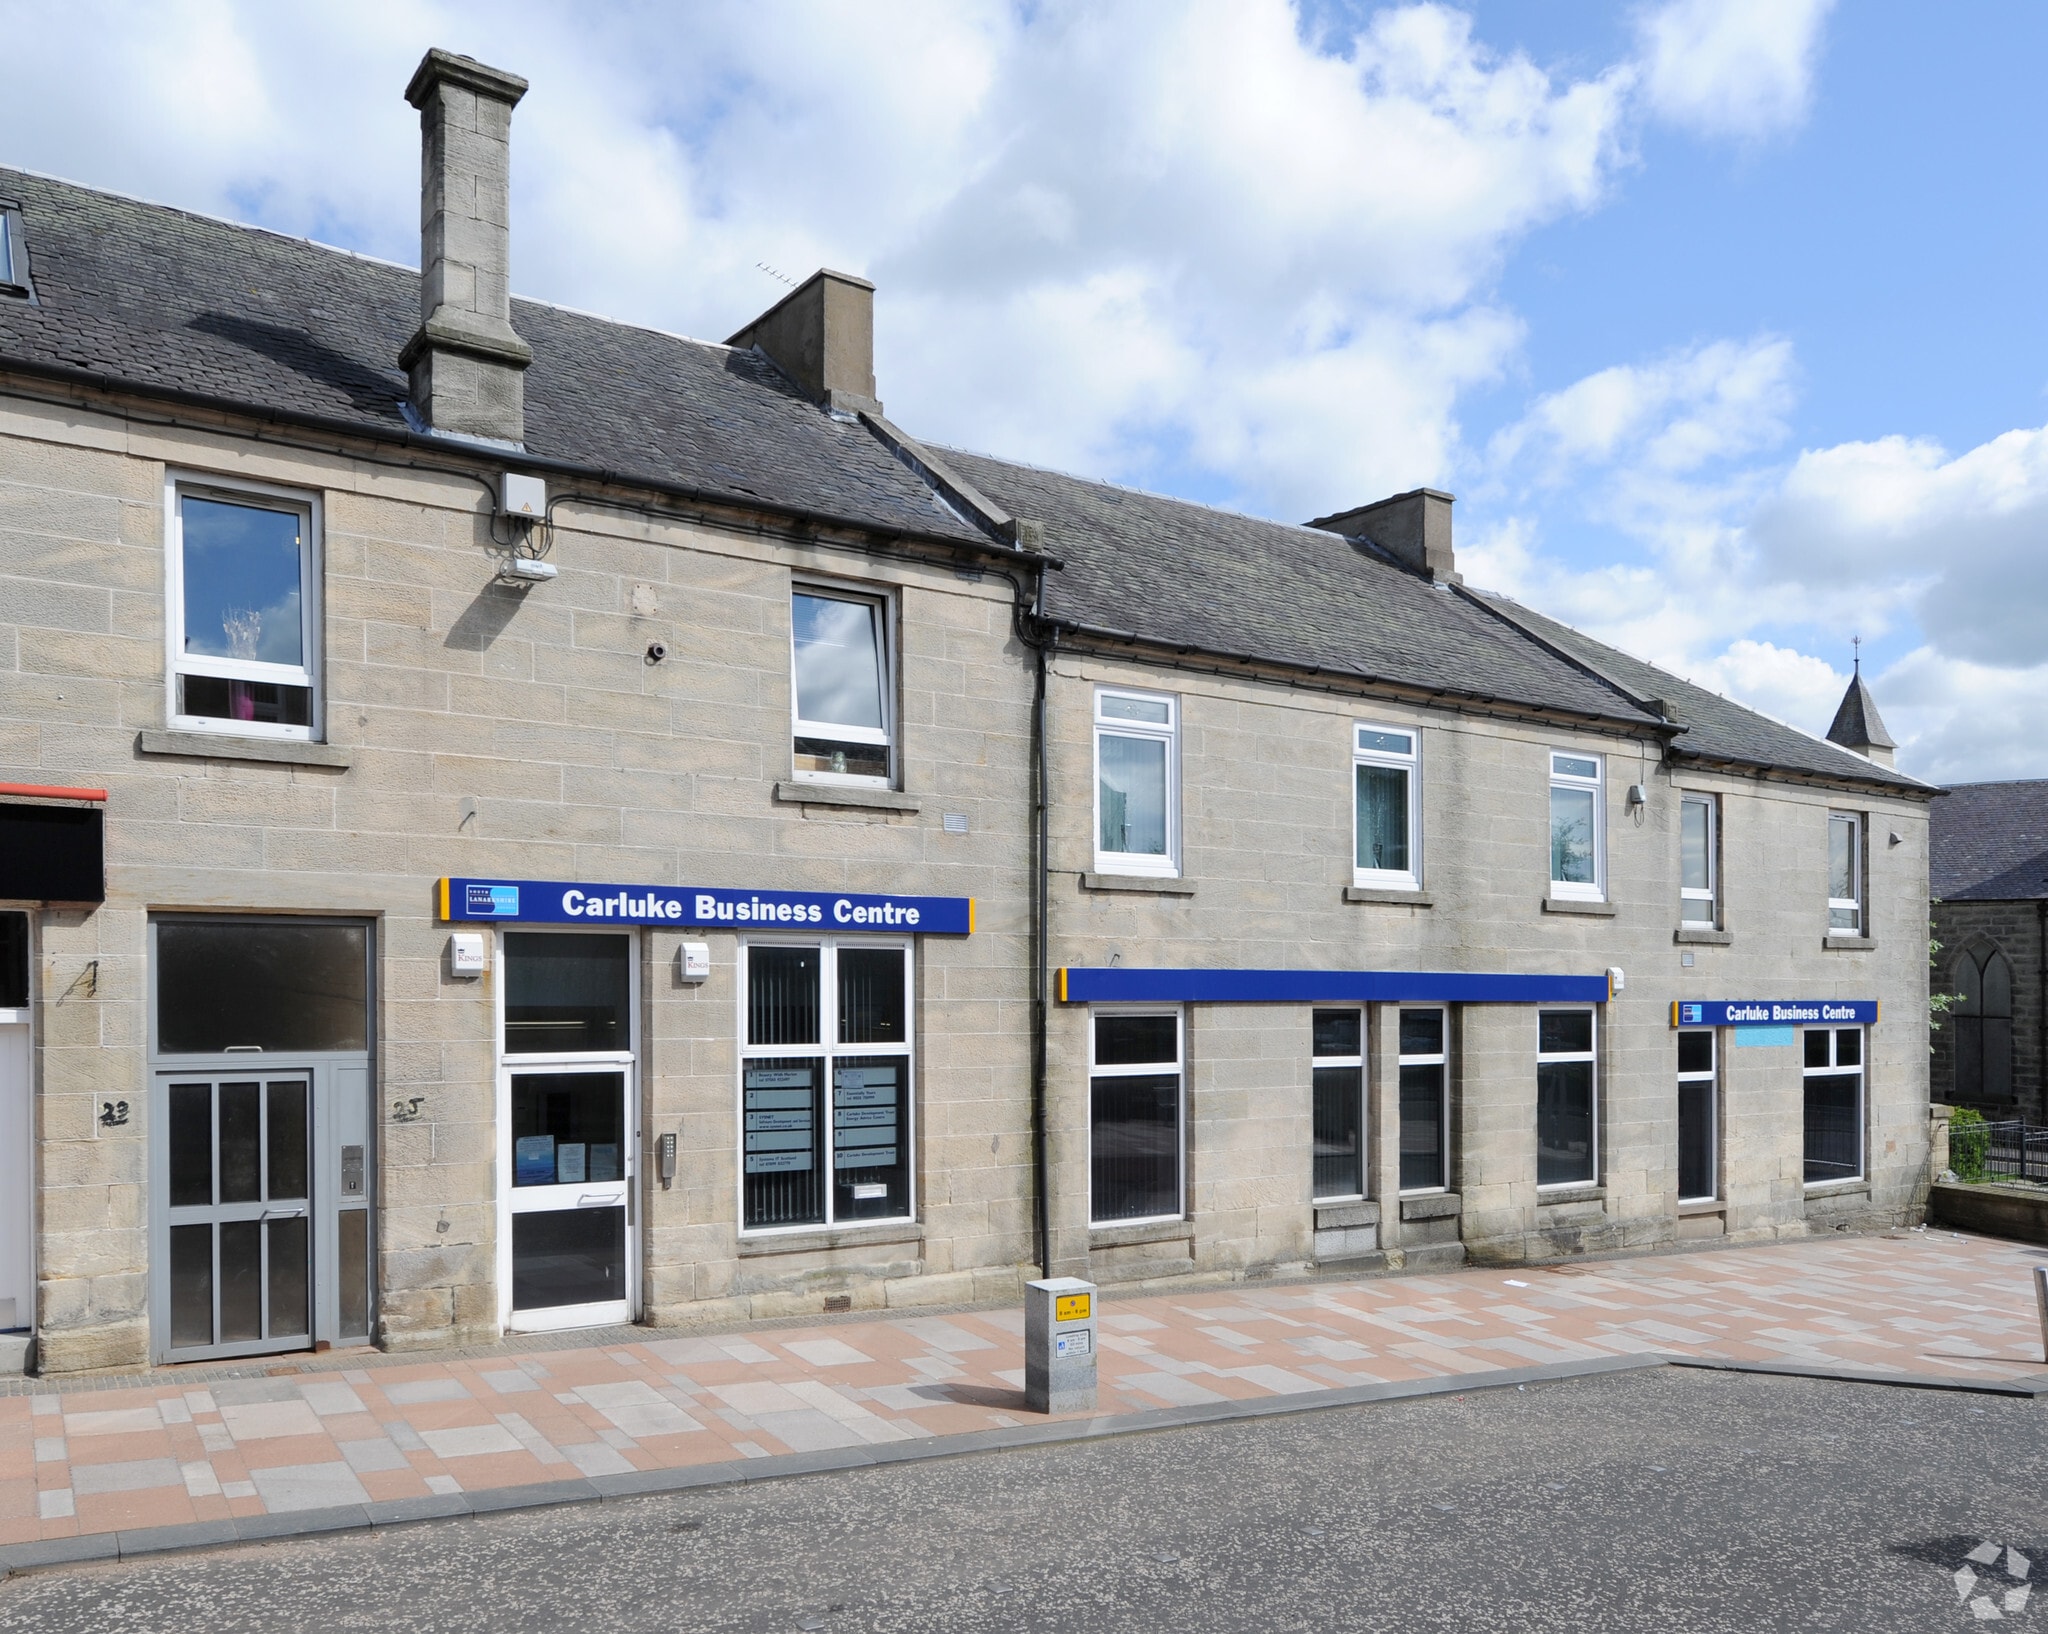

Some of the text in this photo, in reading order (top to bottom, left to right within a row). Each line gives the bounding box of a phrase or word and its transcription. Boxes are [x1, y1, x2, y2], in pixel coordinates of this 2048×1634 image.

[562, 889, 920, 925] Carluke Business Centre
[1726, 1004, 1856, 1021] Carluke Business Centre
